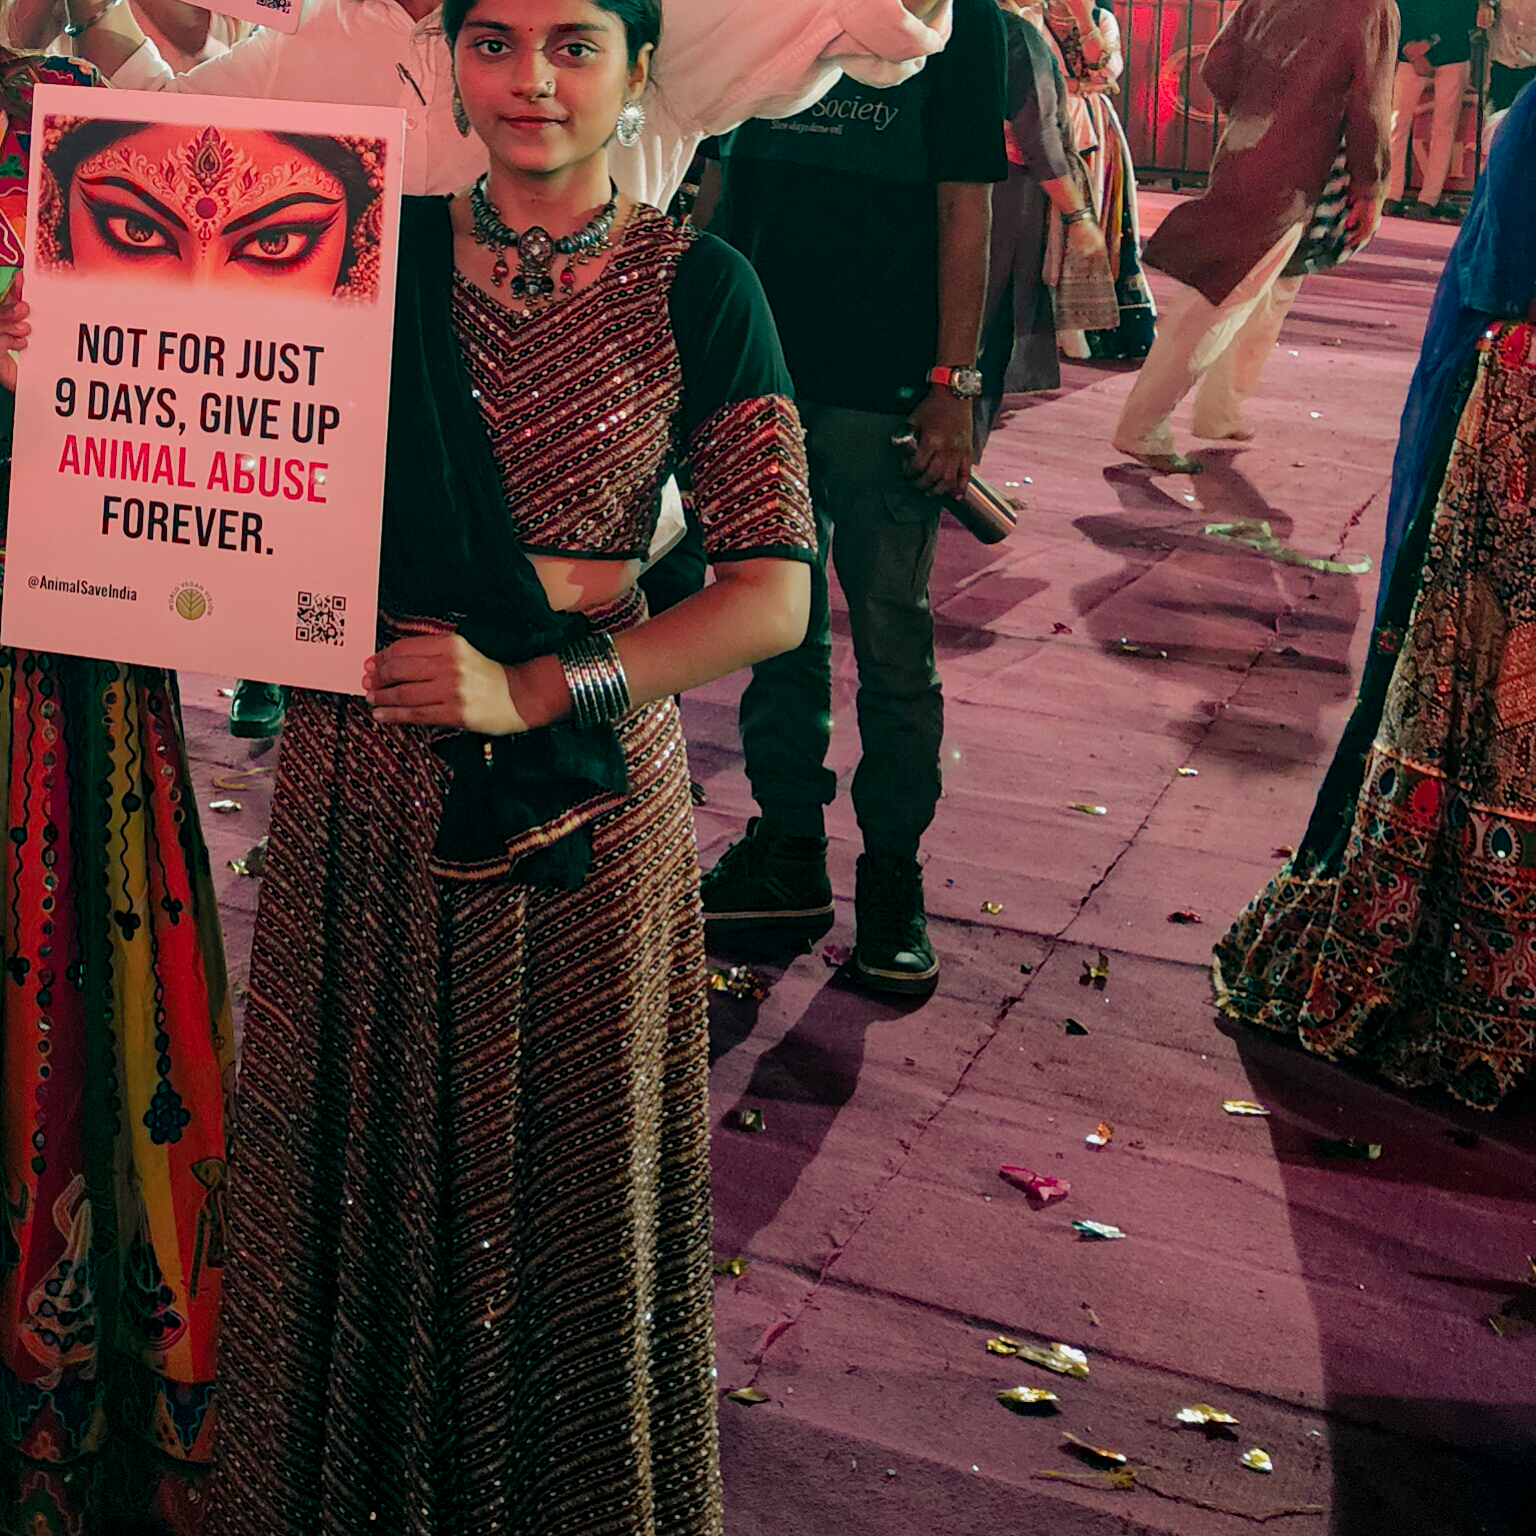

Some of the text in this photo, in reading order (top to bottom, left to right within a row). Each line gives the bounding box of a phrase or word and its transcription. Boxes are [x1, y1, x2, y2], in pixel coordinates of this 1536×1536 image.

[77, 323, 324, 387] NOT FOR JUST
[55, 377, 340, 446] 9 DAYS, GIVE UP
[58, 434, 329, 504] ANIMAL ABUSE
[101, 495, 274, 556] FOREVER.
[27, 575, 138, 602] @AnimalSaveIndia
